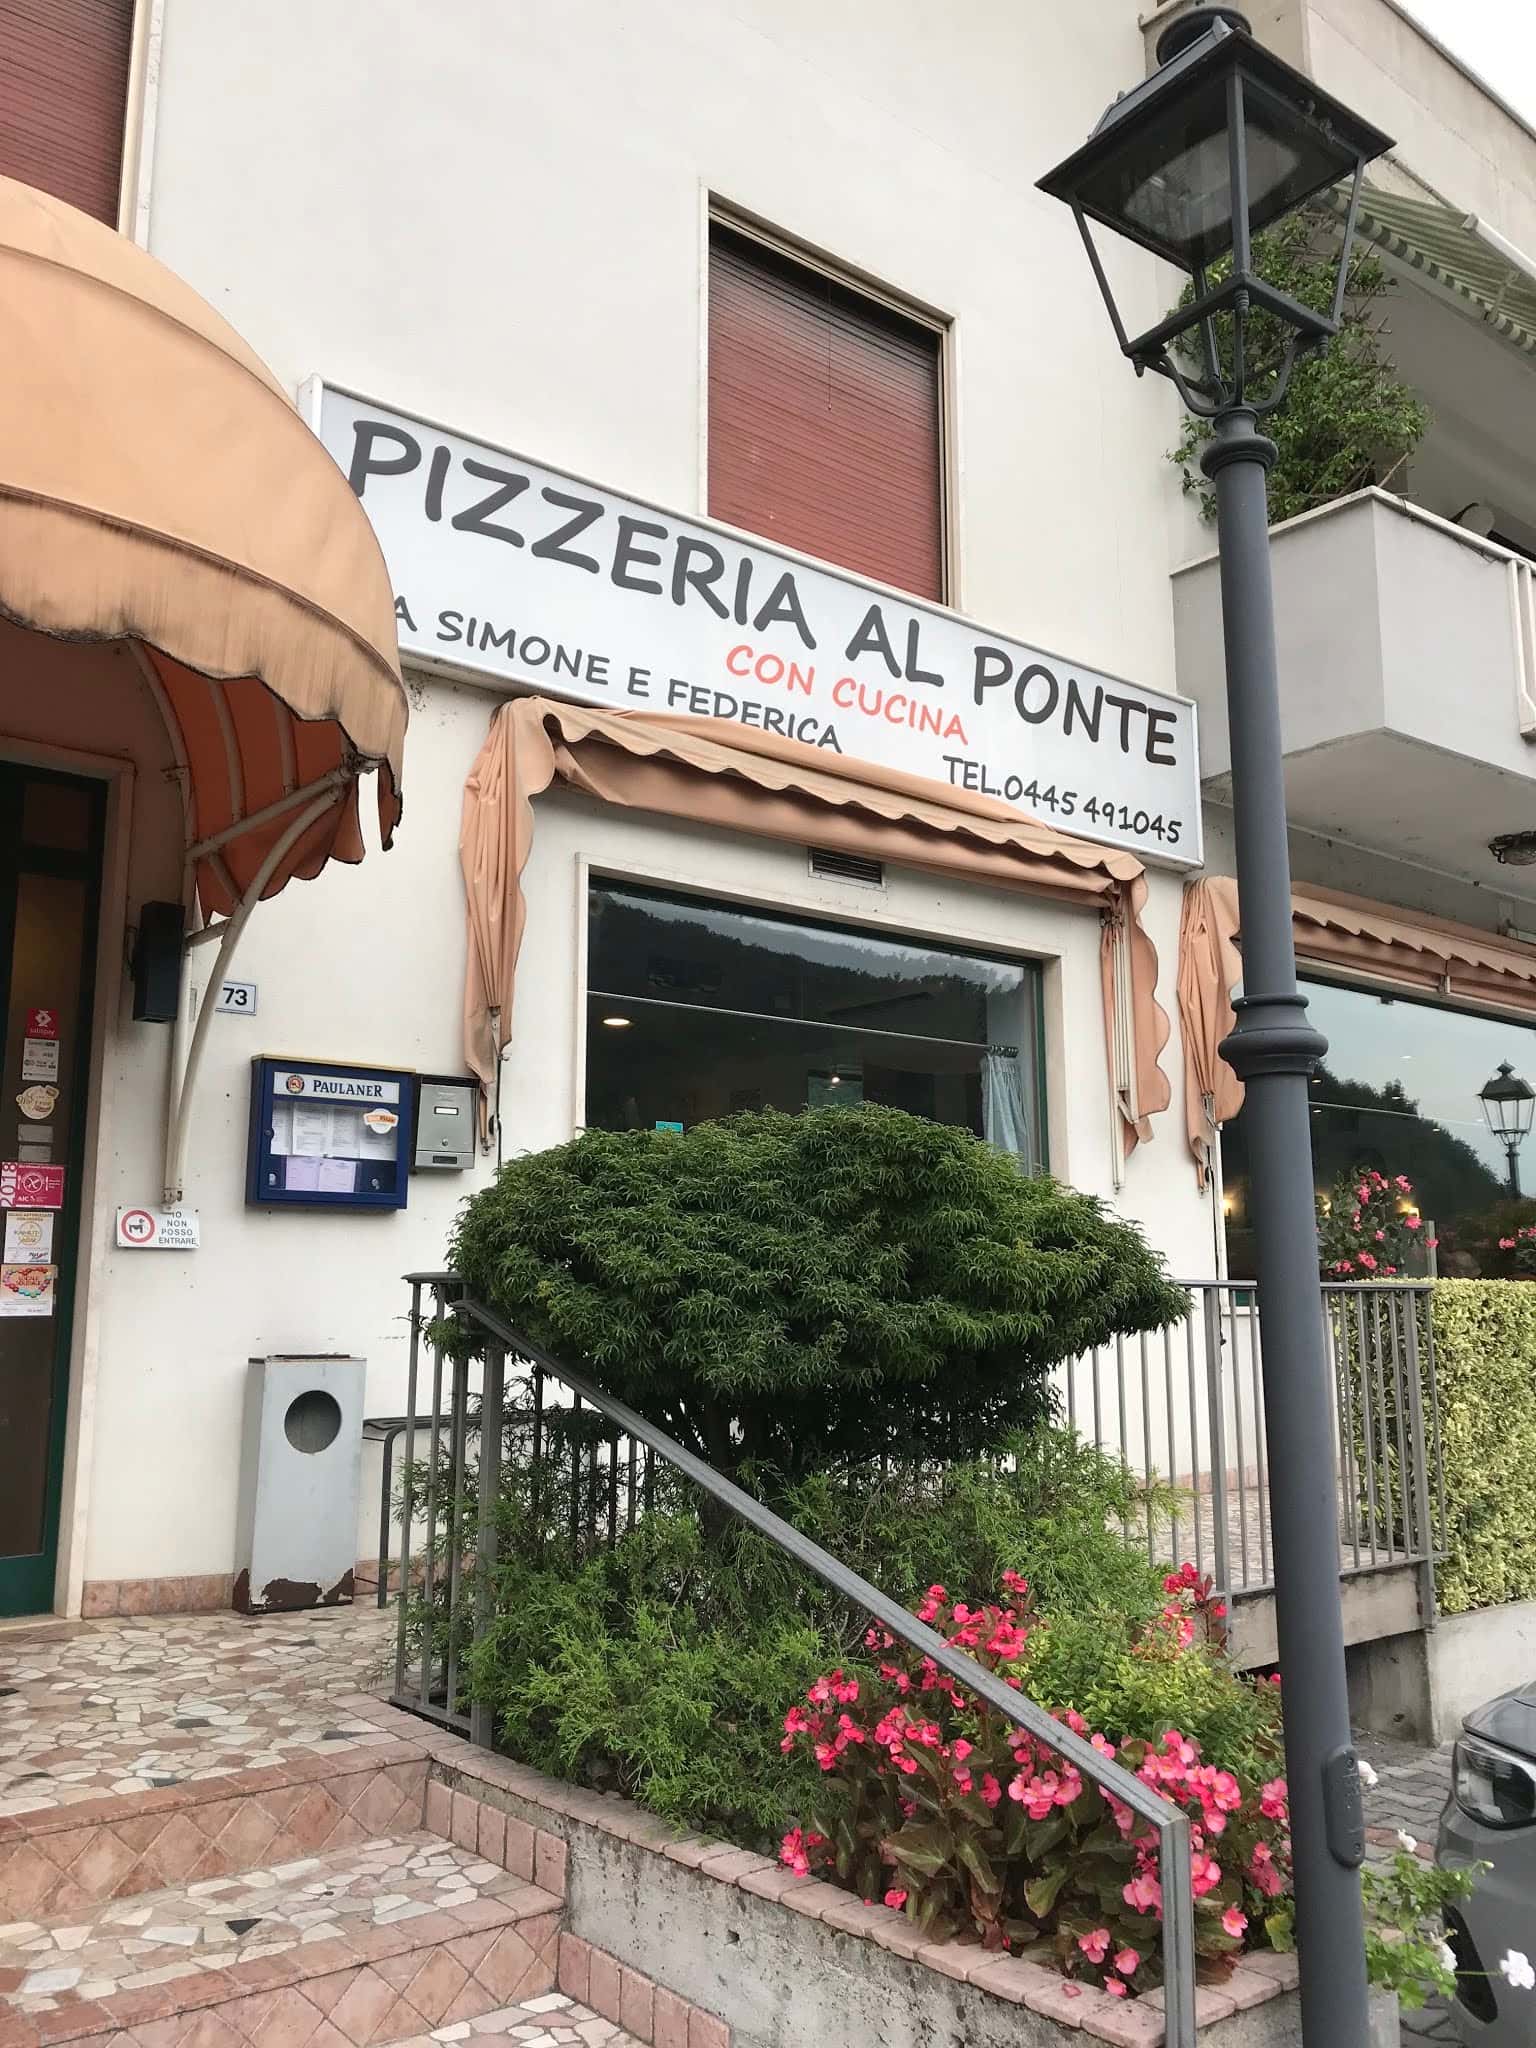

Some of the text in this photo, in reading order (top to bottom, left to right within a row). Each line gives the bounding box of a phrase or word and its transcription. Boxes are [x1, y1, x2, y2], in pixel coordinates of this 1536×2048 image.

[349, 420, 1177, 767] PIZZERIA AL PONTE
[436, 611, 611, 686] SIMONE
[627, 667, 651, 697] E
[667, 678, 843, 754] FEDERICA
[726, 645, 969, 746] CON CUCINA
[1083, 797, 1183, 844] 491045
[222, 987, 248, 1006] 73
[313, 1079, 383, 1098] PAULANER
[161, 1228, 193, 1236] POSSO
[167, 1219, 187, 1227] NON
[159, 1237, 197, 1245] ENTRARE
